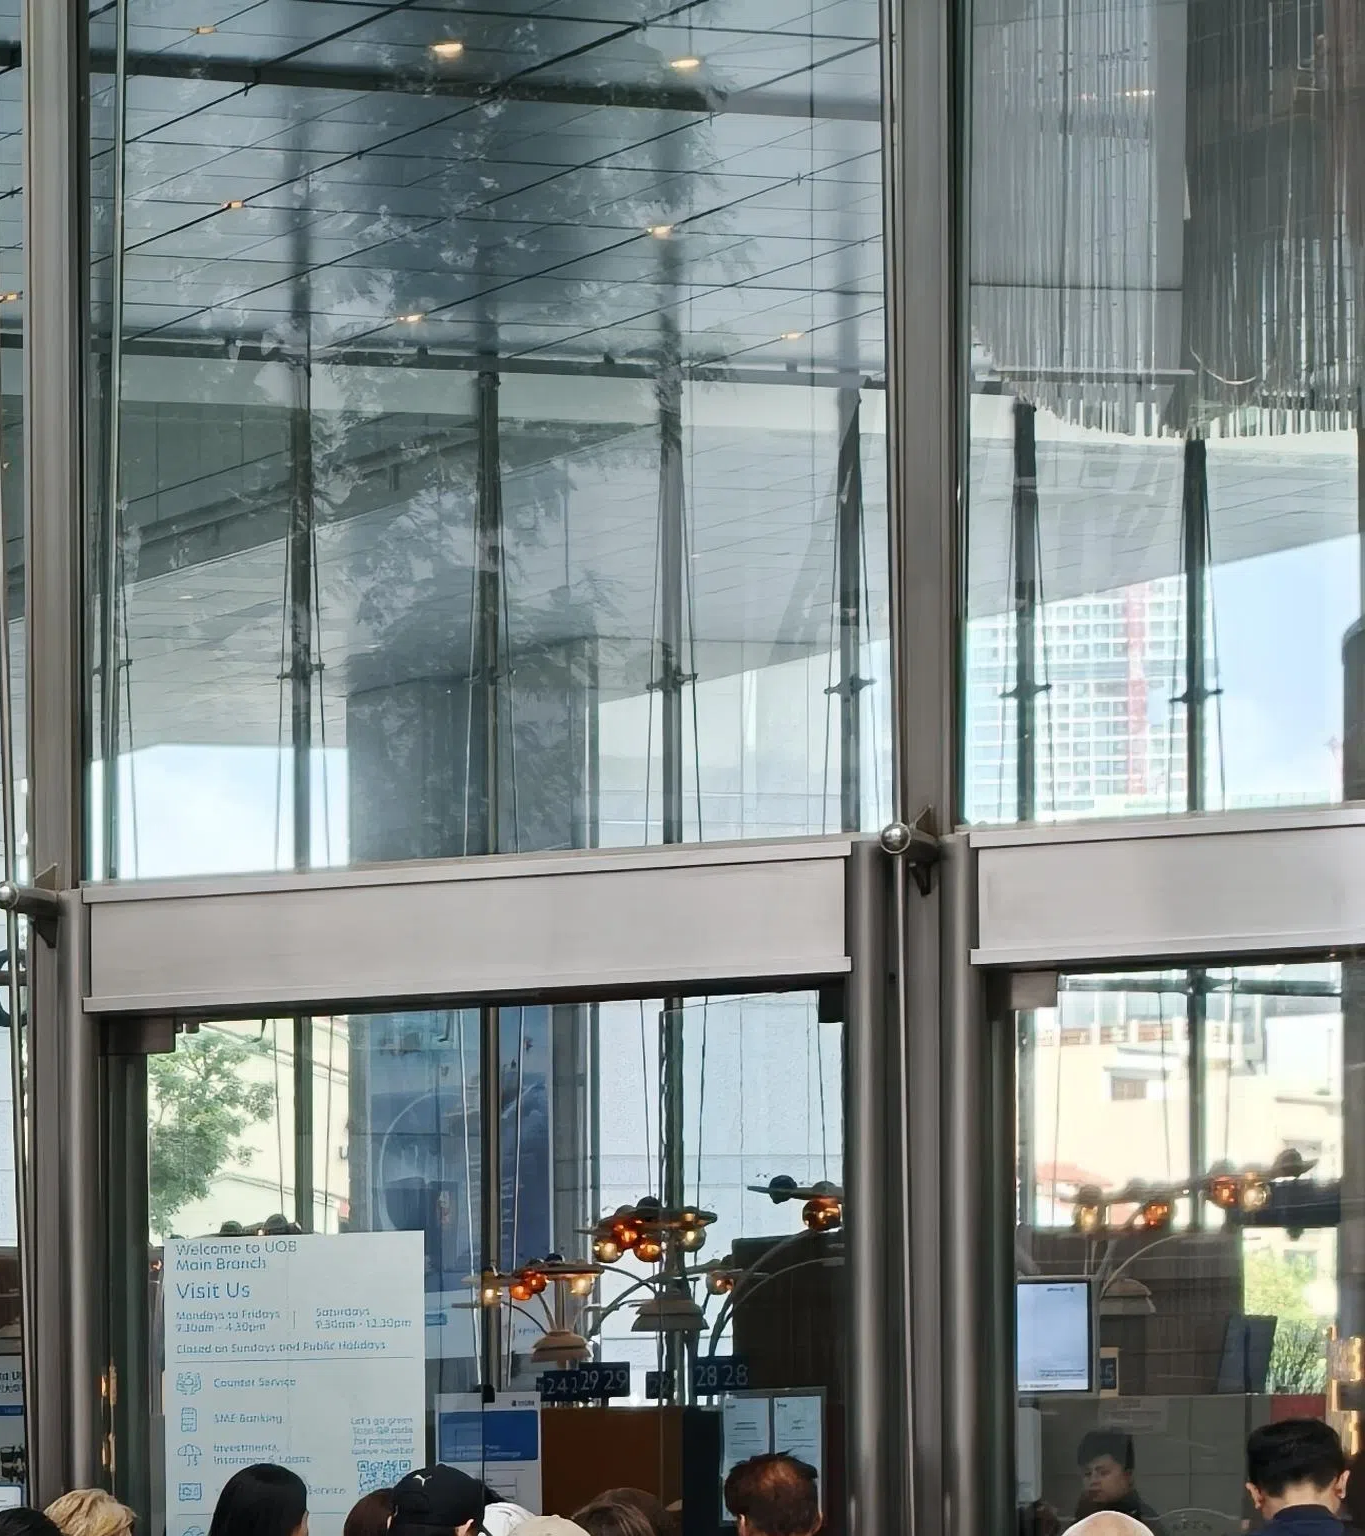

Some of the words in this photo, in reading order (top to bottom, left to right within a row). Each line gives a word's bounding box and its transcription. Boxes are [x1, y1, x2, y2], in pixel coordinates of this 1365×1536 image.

[175, 1243, 242, 1256] Welcome
[245, 1243, 261, 1254] to
[264, 1240, 298, 1254] UOB
[176, 1258, 213, 1272] Main
[216, 1256, 267, 1271] Branch
[176, 1281, 221, 1300] Visit
[226, 1282, 251, 1299] Us
[176, 1310, 225, 1321] Mondays
[227, 1311, 239, 1320] to
[241, 1309, 281, 1321] Fridays
[316, 1307, 371, 1318] Saturdays
[176, 1343, 213, 1355] Closed
[215, 1345, 229, 1354] on
[231, 1343, 277, 1354] Sundays
[303, 1340, 336, 1351] Public
[338, 1339, 387, 1351] Holidays
[213, 1378, 256, 1389] Counter
[258, 1377, 297, 1389] Service
[603, 1370, 628, 1391] 29
[695, 1365, 718, 1387] 28
[723, 1364, 749, 1387] 28
